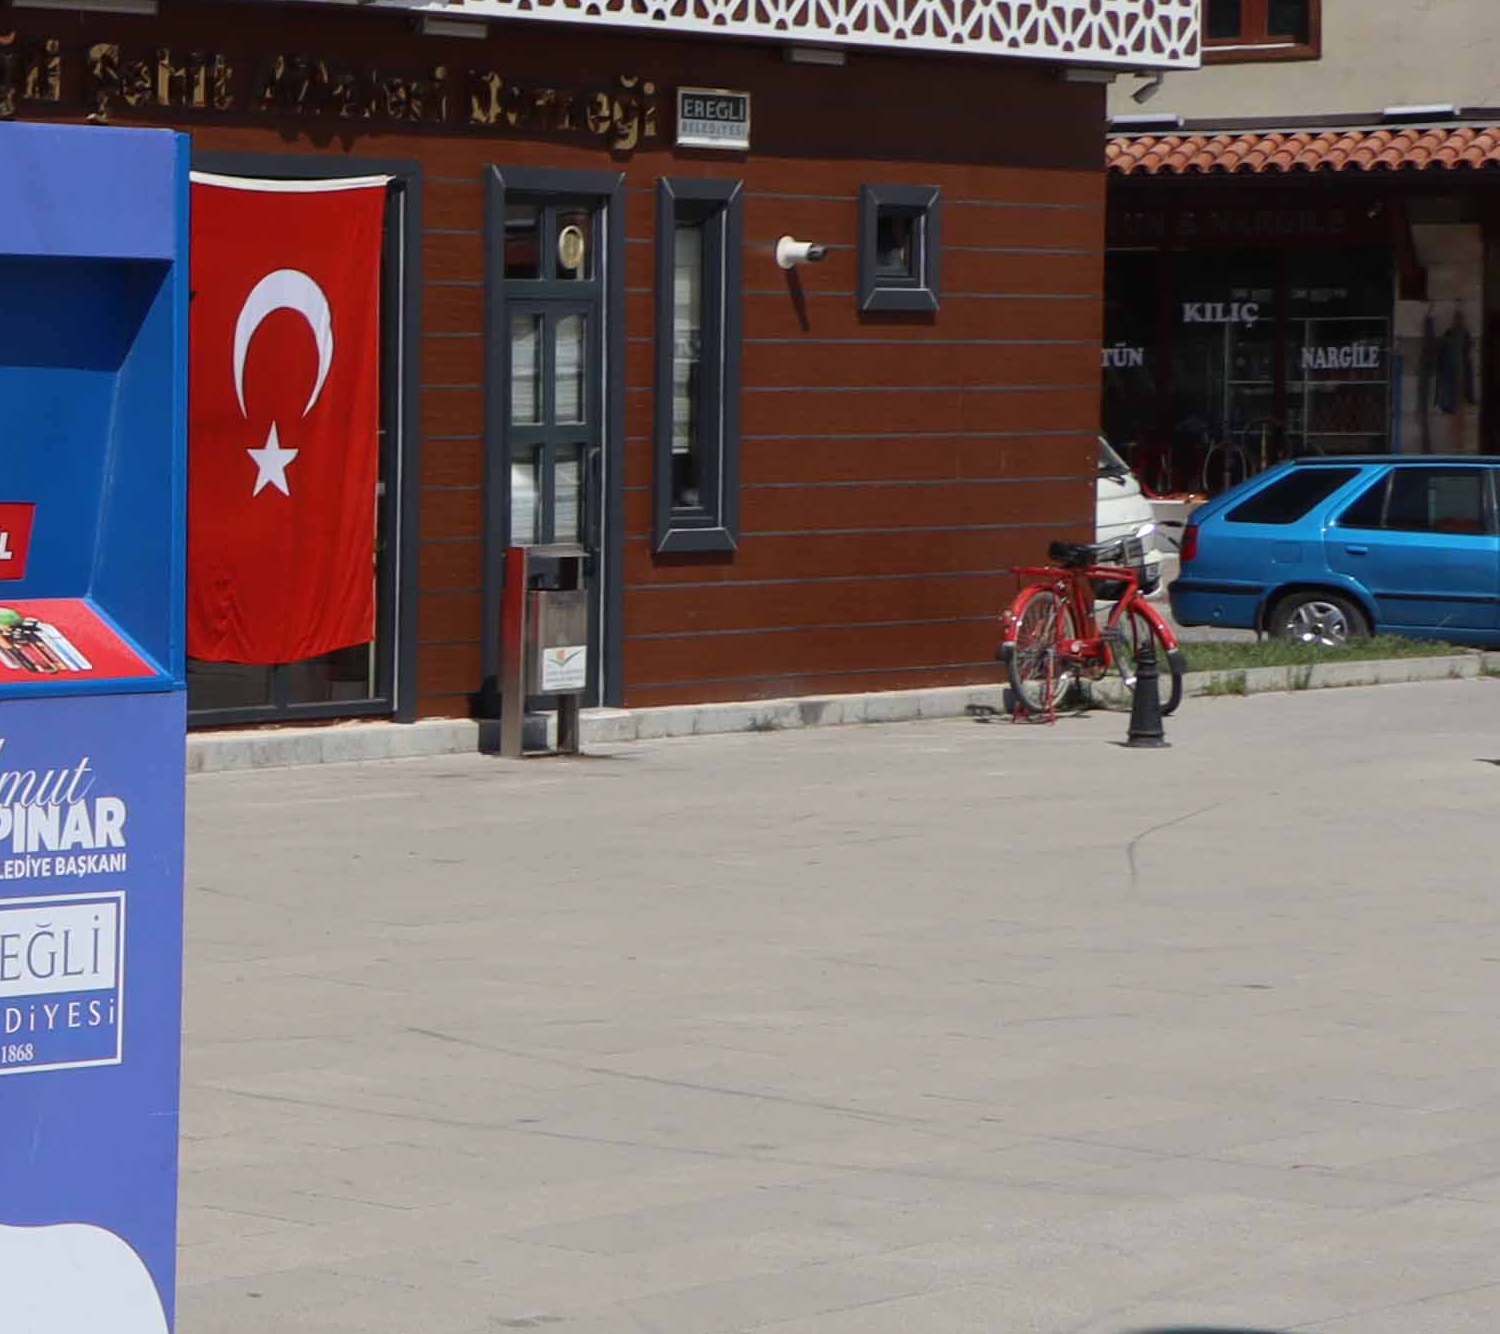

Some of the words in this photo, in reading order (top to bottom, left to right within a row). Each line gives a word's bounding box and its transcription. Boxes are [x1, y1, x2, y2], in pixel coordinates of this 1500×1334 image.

[1182, 302, 1260, 330] KILIÇ
[1301, 343, 1381, 370] NARGİLE
[55, 853, 128, 878] BAŞKANI
[1, 1043, 34, 1065] 1868
